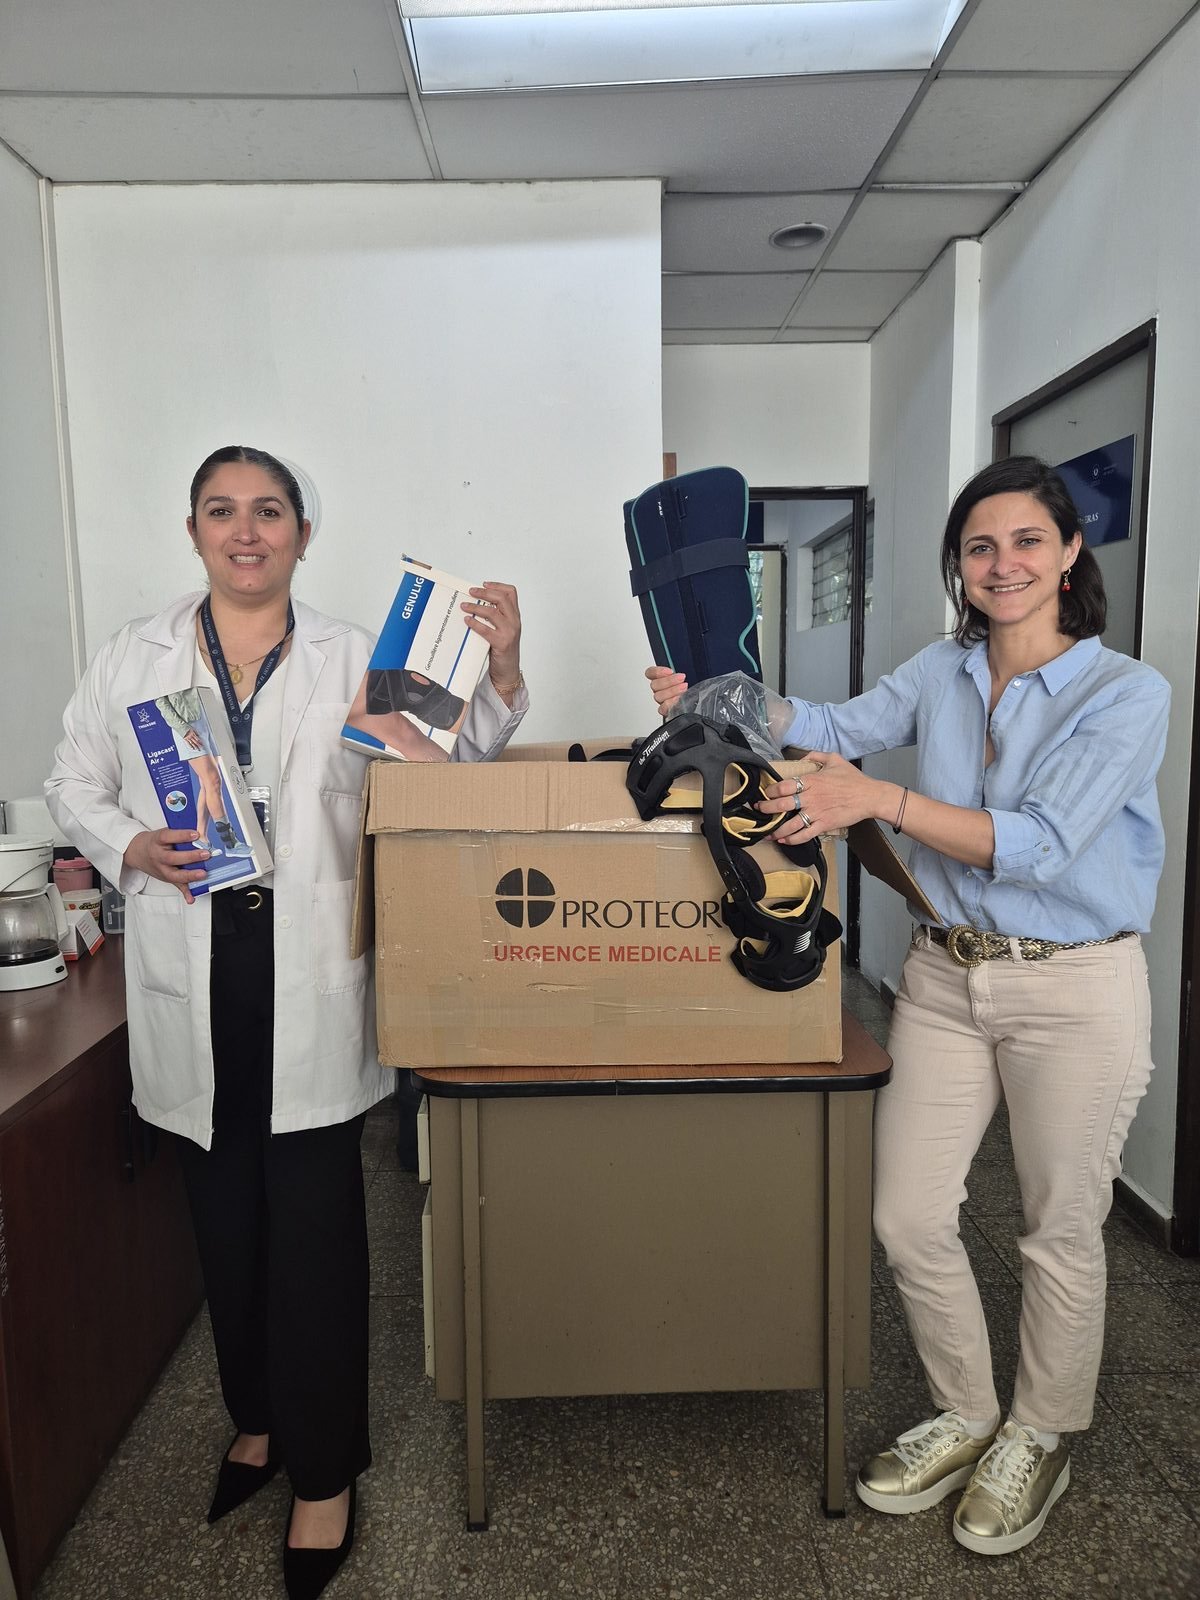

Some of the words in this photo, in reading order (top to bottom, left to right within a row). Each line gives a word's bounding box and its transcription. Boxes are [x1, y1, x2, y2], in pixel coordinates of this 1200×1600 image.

[402, 575, 425, 620] GENULIG
[641, 730, 669, 757] Tradition
[150, 758, 160, 766] Air
[562, 900, 723, 929] PROTEOR
[495, 945, 601, 962] URGENCE
[608, 945, 721, 962] MEDICALE
